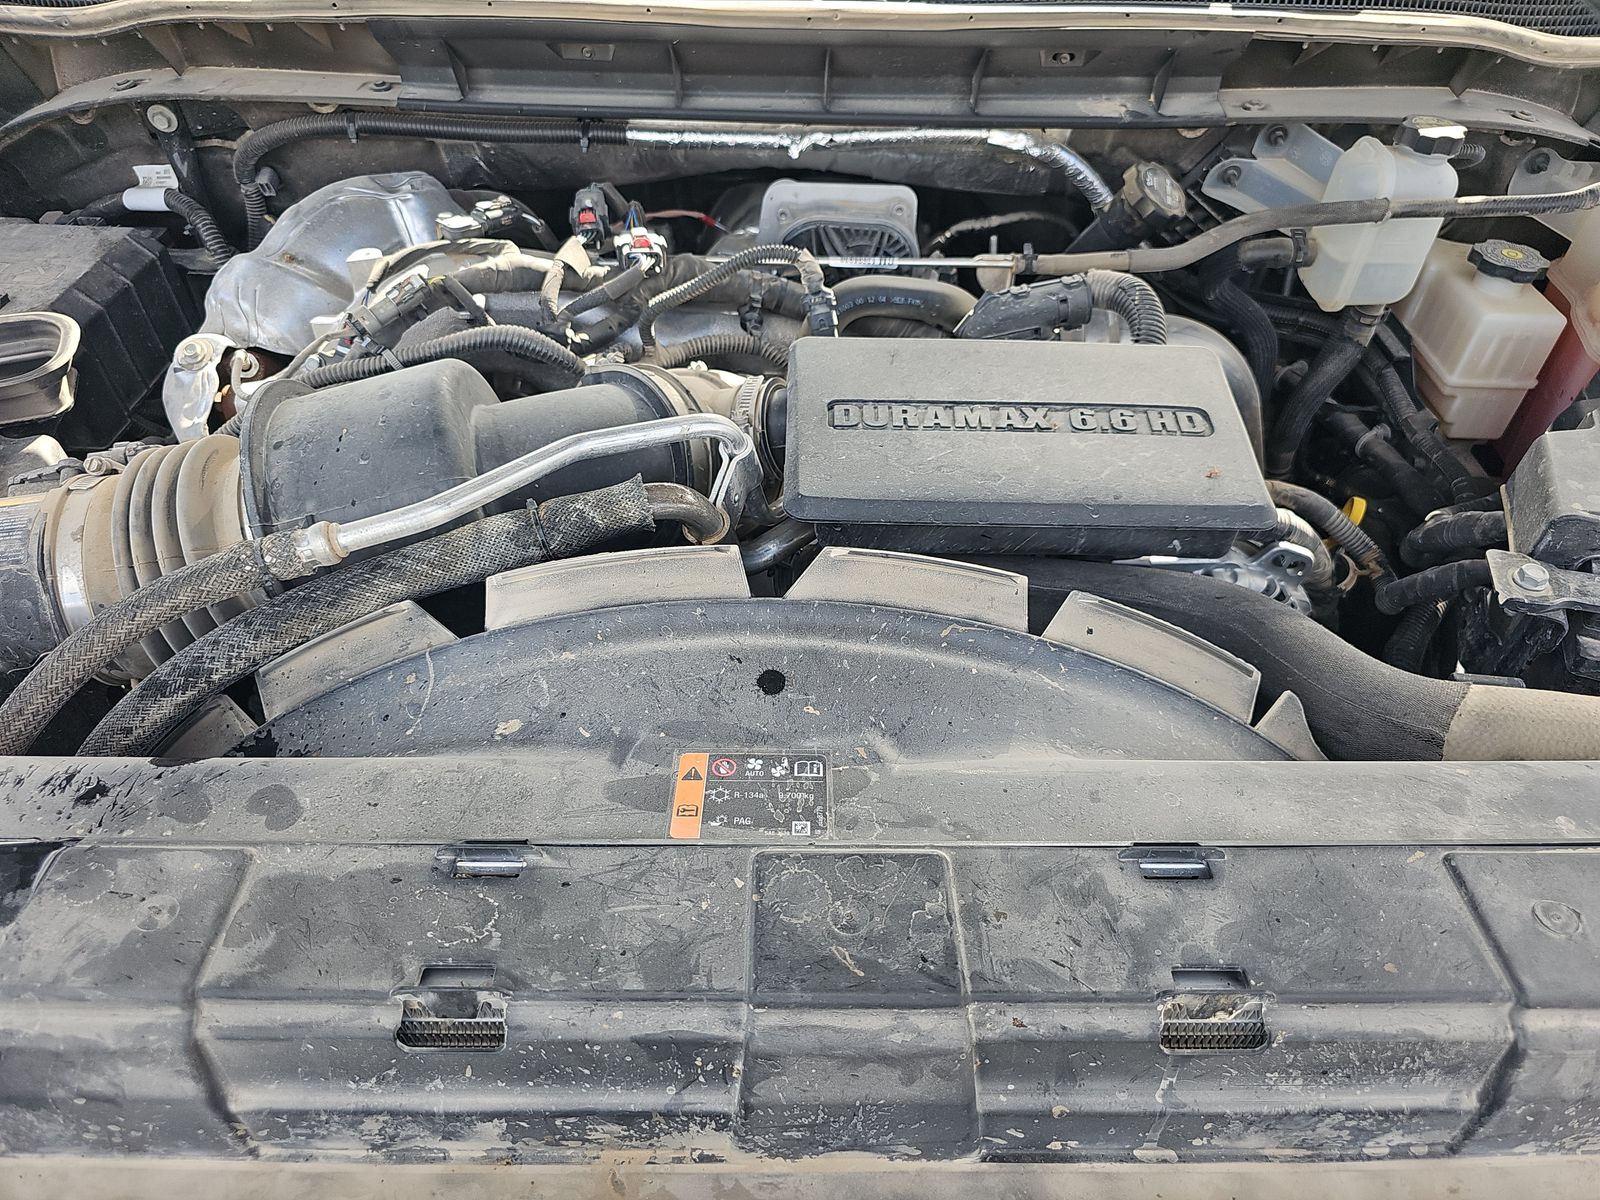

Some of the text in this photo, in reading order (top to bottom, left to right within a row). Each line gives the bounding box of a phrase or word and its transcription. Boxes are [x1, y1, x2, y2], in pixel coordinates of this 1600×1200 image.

[832, 403, 1210, 436] DURAMAX 6.6 HD
